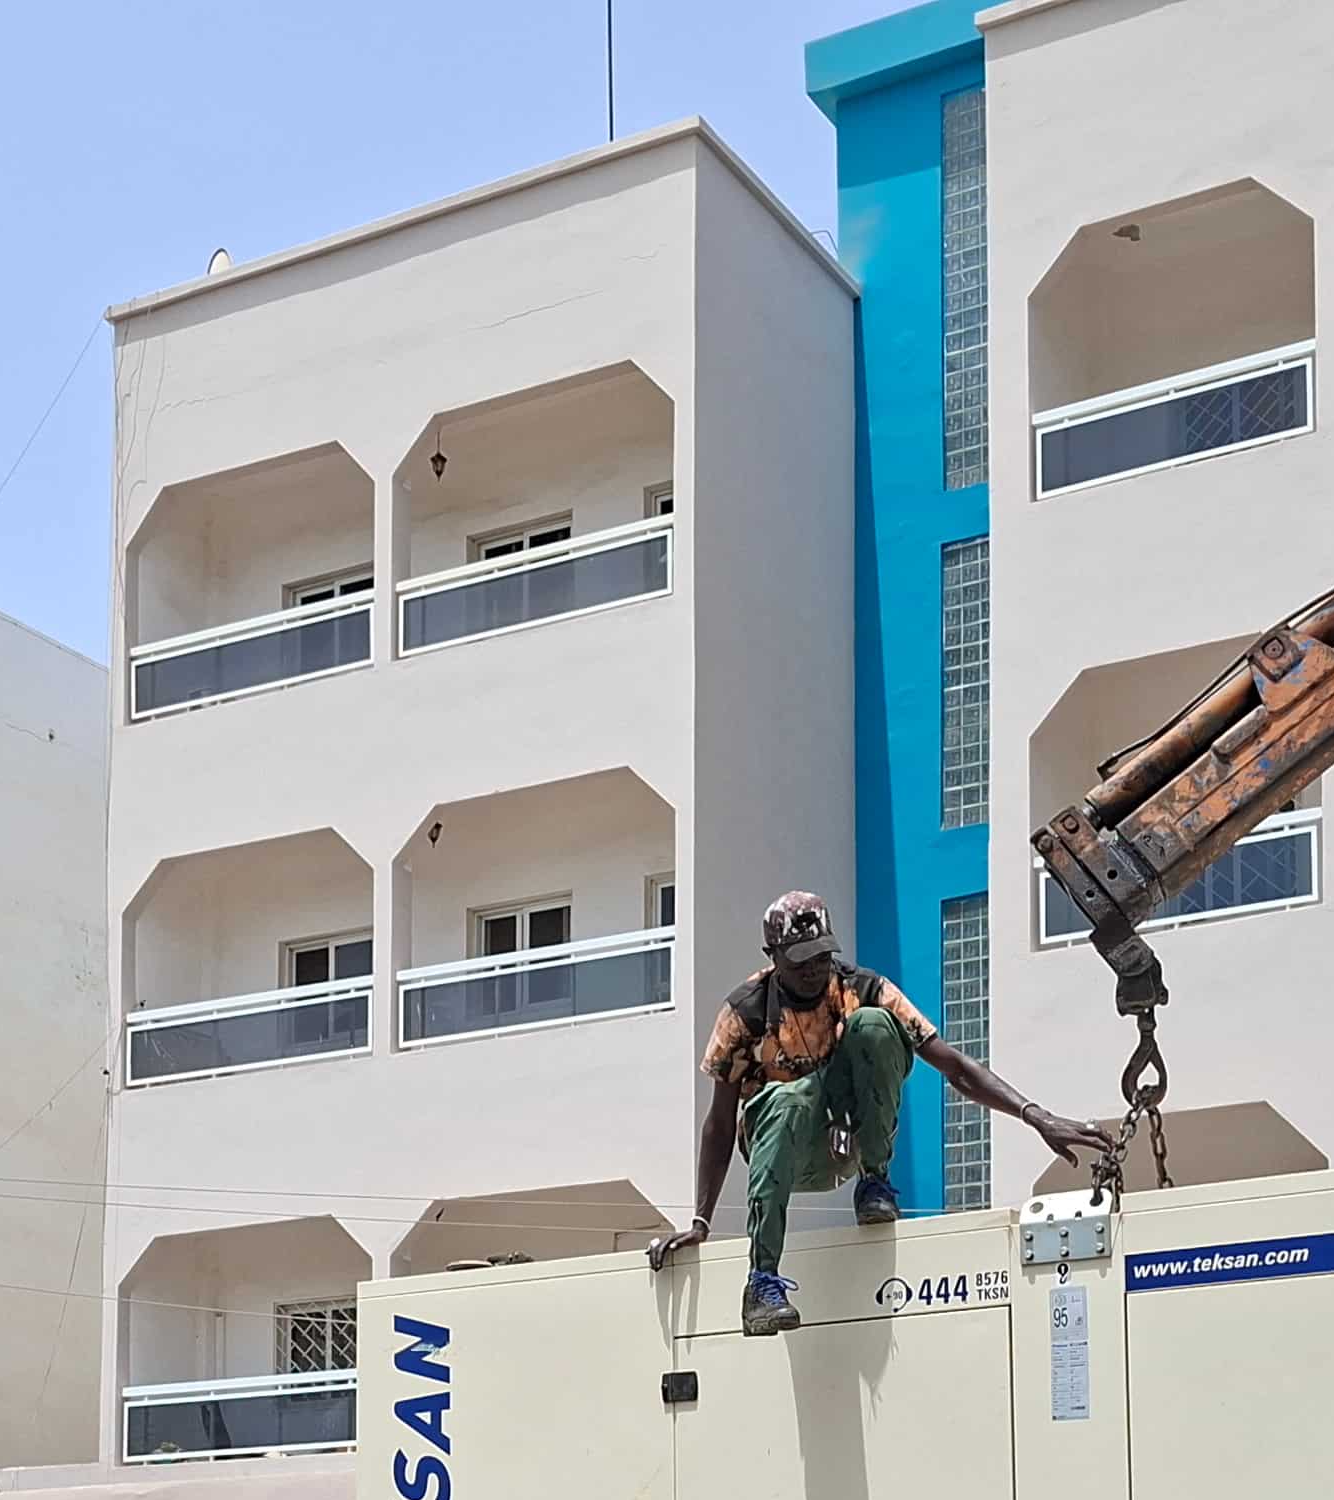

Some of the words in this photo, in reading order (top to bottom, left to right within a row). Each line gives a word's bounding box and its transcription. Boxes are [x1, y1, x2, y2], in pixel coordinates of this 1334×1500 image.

[1133, 1246, 1309, 1279] www.teksan.com
[975, 1270, 1009, 1288] 8576
[918, 1275, 968, 1306] 444
[976, 1286, 1010, 1301] TKSN
[1053, 1307, 1068, 1328] 95
